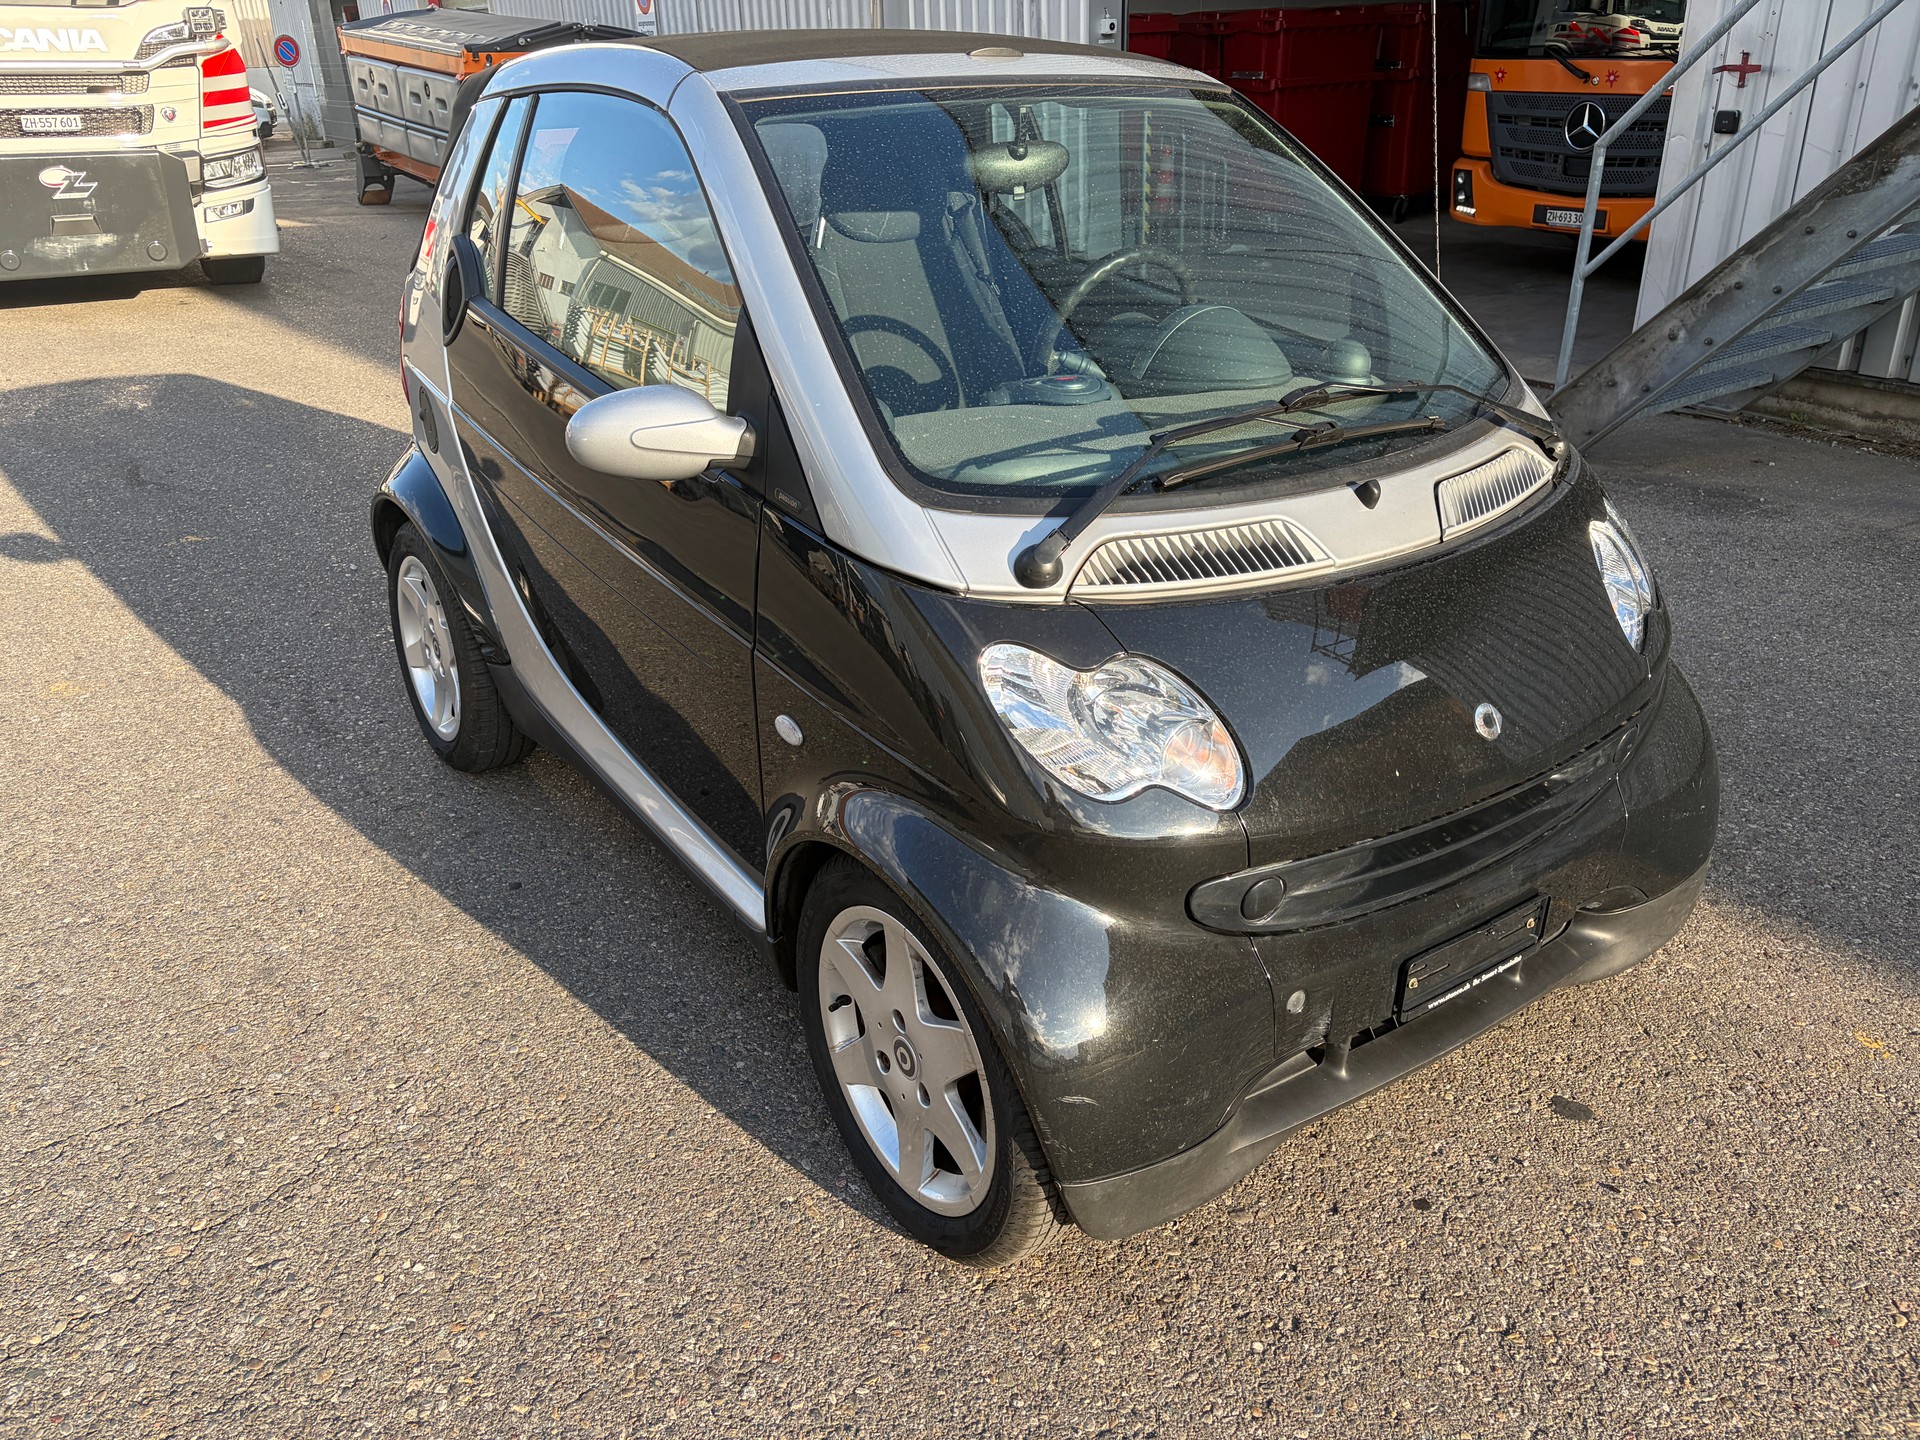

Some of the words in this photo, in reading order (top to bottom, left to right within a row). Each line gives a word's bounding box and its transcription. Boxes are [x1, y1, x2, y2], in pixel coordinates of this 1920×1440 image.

[60, 117, 80, 128] 601
[1573, 213, 1584, 224] 30
[1481, 968, 1498, 982] Smart
